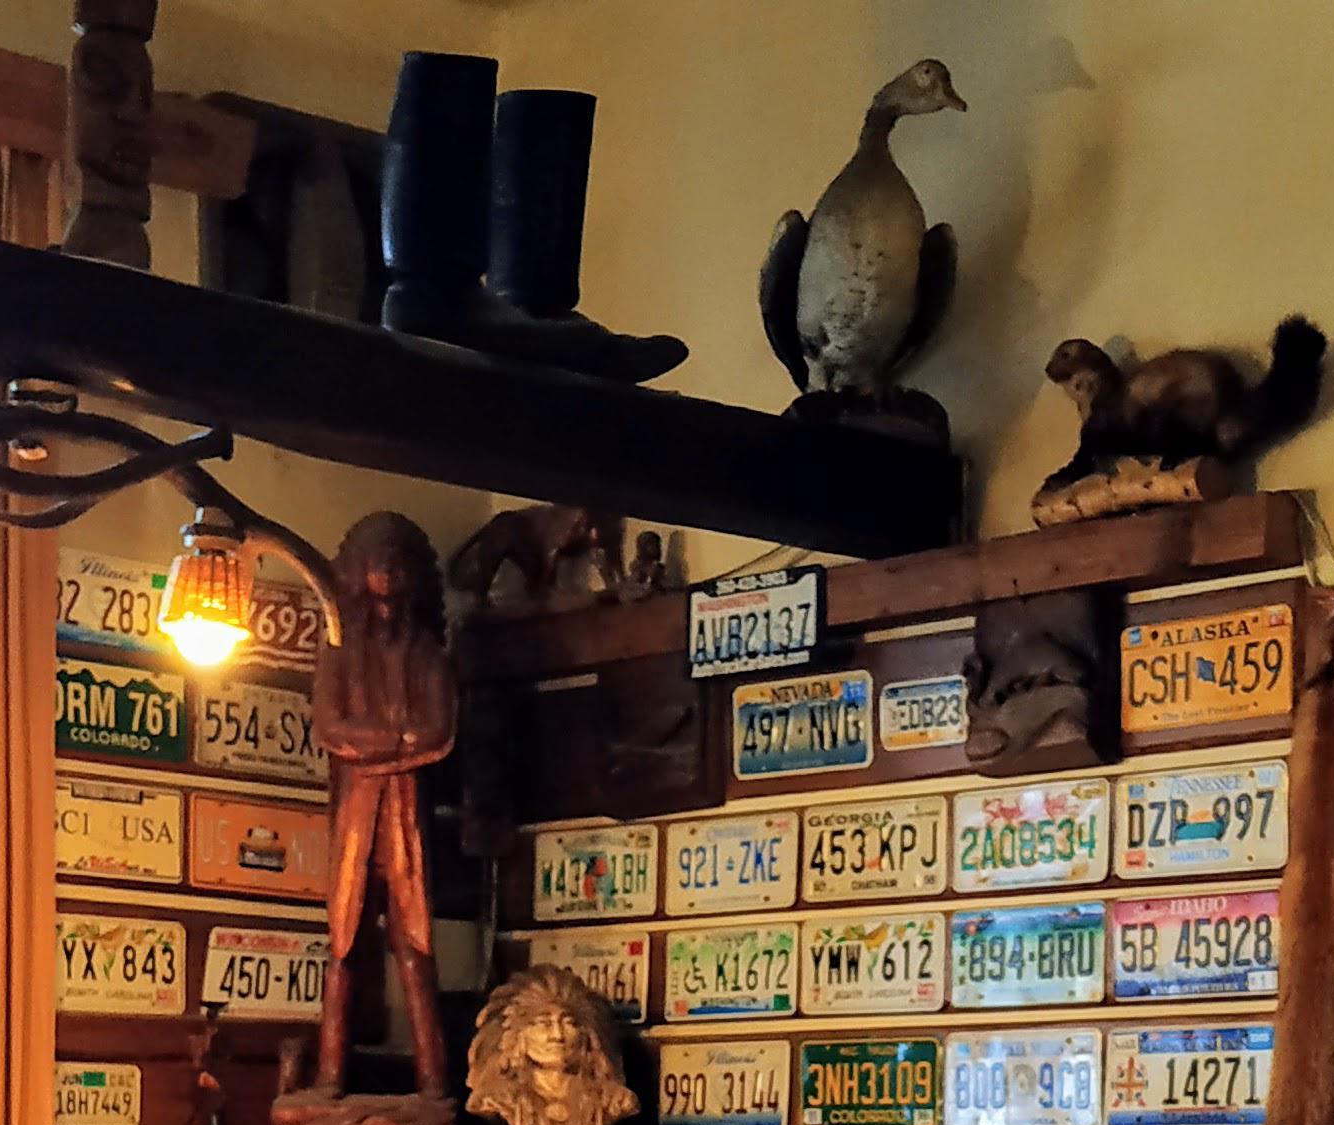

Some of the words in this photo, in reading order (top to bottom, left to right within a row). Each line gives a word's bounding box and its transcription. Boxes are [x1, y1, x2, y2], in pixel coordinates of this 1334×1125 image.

[101, 585, 154, 638] 283
[251, 598, 318, 650] 692
[1161, 620, 1251, 647] ALASKA
[771, 683, 834, 704] NEVADA
[1128, 651, 1191, 709] CSH
[1218, 639, 1284, 695] 459
[69, 726, 153, 750] COLORADO
[128, 692, 179, 737] 761
[121, 815, 175, 844] USA
[807, 810, 894, 828] GEORGIA
[1212, 789, 1276, 841] 997
[678, 843, 719, 890] 921
[737, 836, 782, 884] ZKE
[809, 827, 867, 877] 453
[878, 821, 939, 872] KPJ
[122, 944, 176, 986] 843
[881, 939, 933, 982] 612
[1120, 922, 1159, 974] 5B
[1174, 913, 1273, 970] 45928
[219, 953, 327, 1003] 450-KD
[716, 948, 791, 993] K1672
[664, 1072, 708, 1116] 990
[721, 1069, 780, 1115] 3144
[807, 1060, 934, 1107] 3NH3109
[1161, 1056, 1261, 1106] 14271
